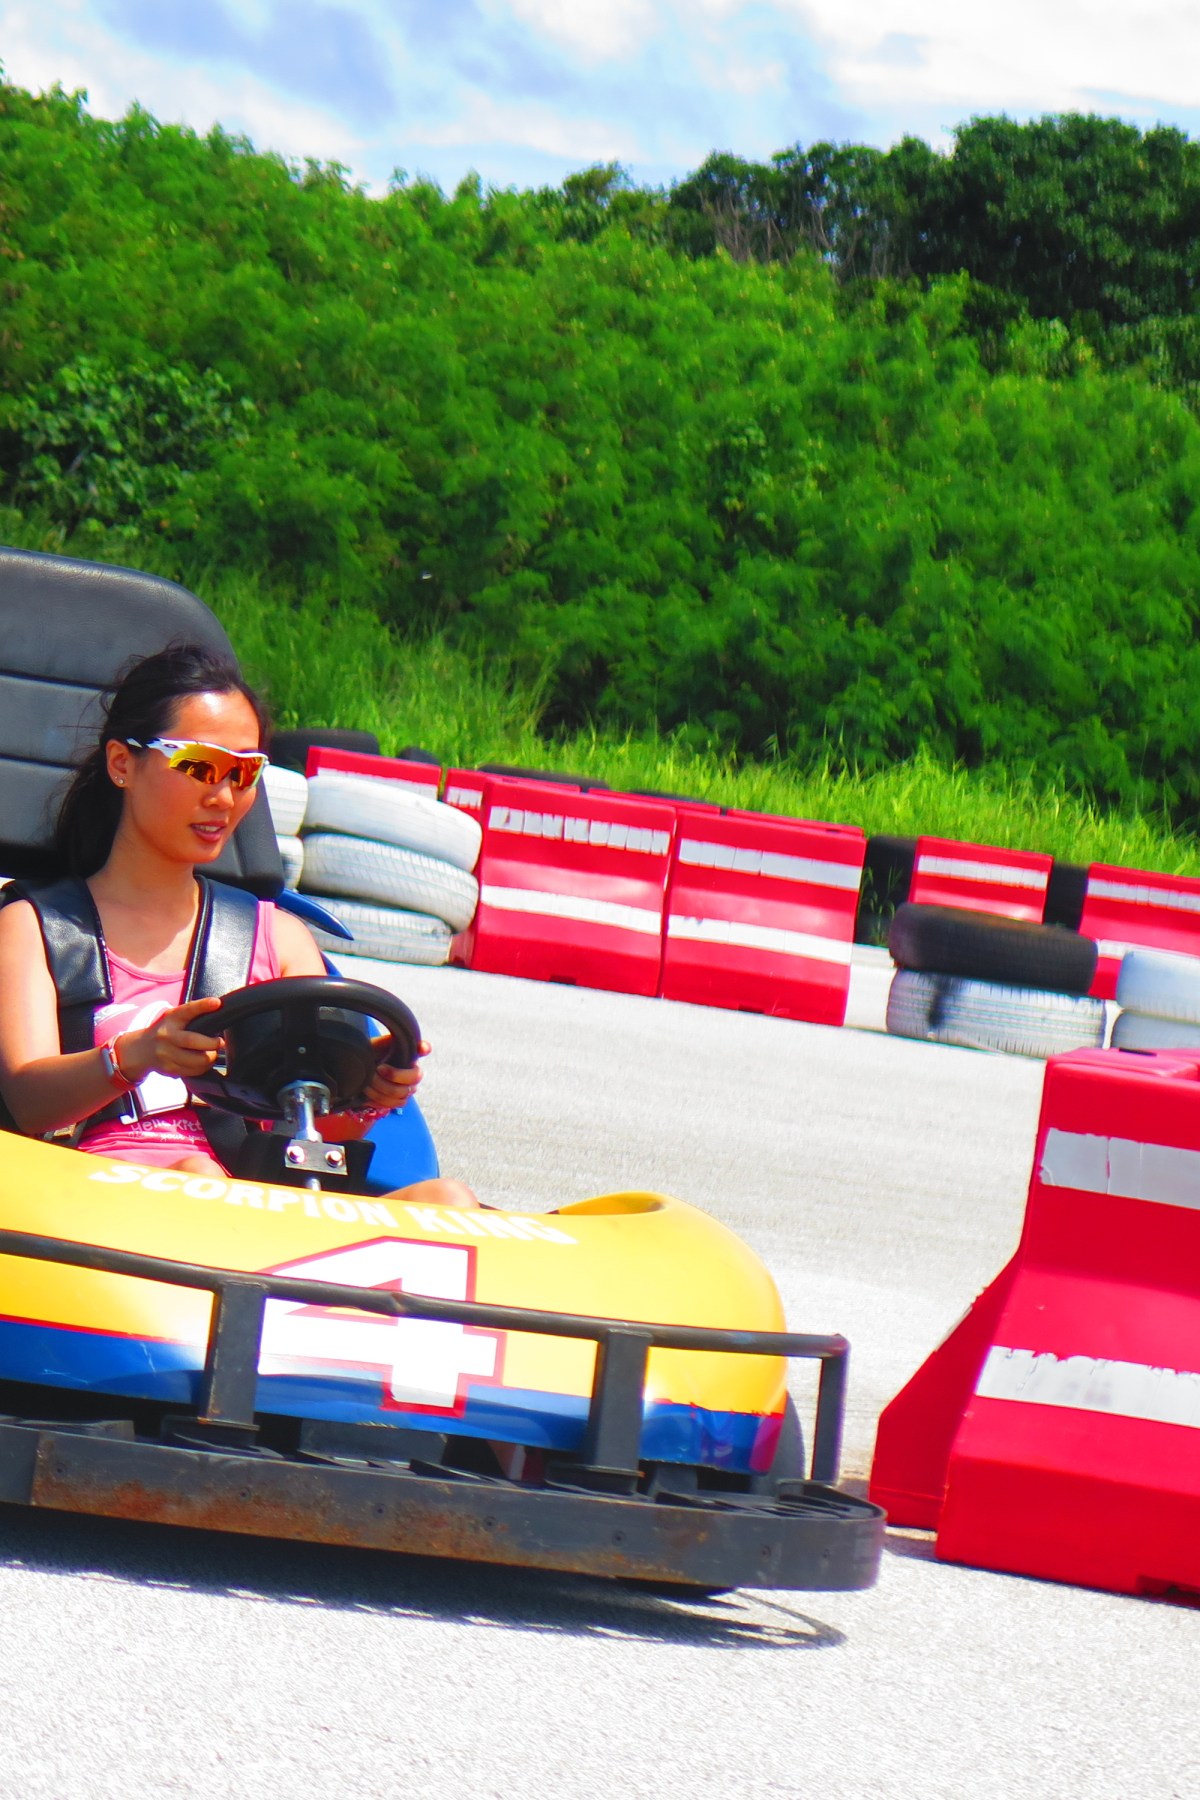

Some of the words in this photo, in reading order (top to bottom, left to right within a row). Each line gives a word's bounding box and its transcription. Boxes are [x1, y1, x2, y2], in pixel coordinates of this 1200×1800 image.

[172, 1119, 203, 1132] Kitt
[88, 1165, 399, 1228] SCORPION
[403, 1206, 579, 1244] KING
[255, 1236, 507, 1418] 4
